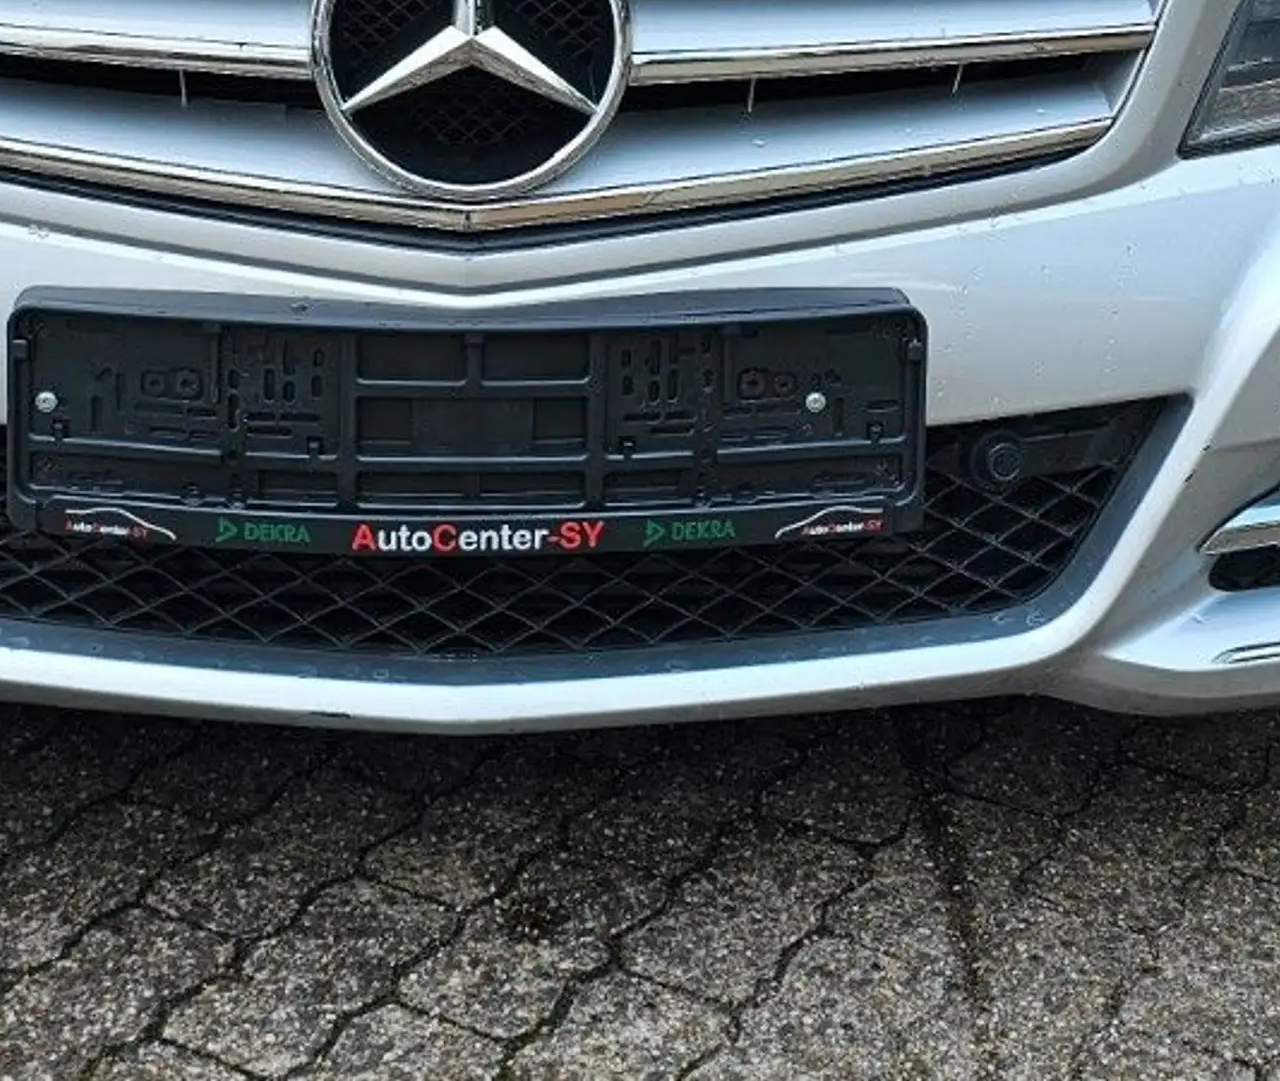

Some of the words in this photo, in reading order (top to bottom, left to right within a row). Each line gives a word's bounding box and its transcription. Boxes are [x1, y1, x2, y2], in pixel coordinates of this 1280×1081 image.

[243, 521, 311, 543] DEKRA
[351, 520, 605, 552] AutoCenter-SY
[671, 519, 736, 541] DEKRA
